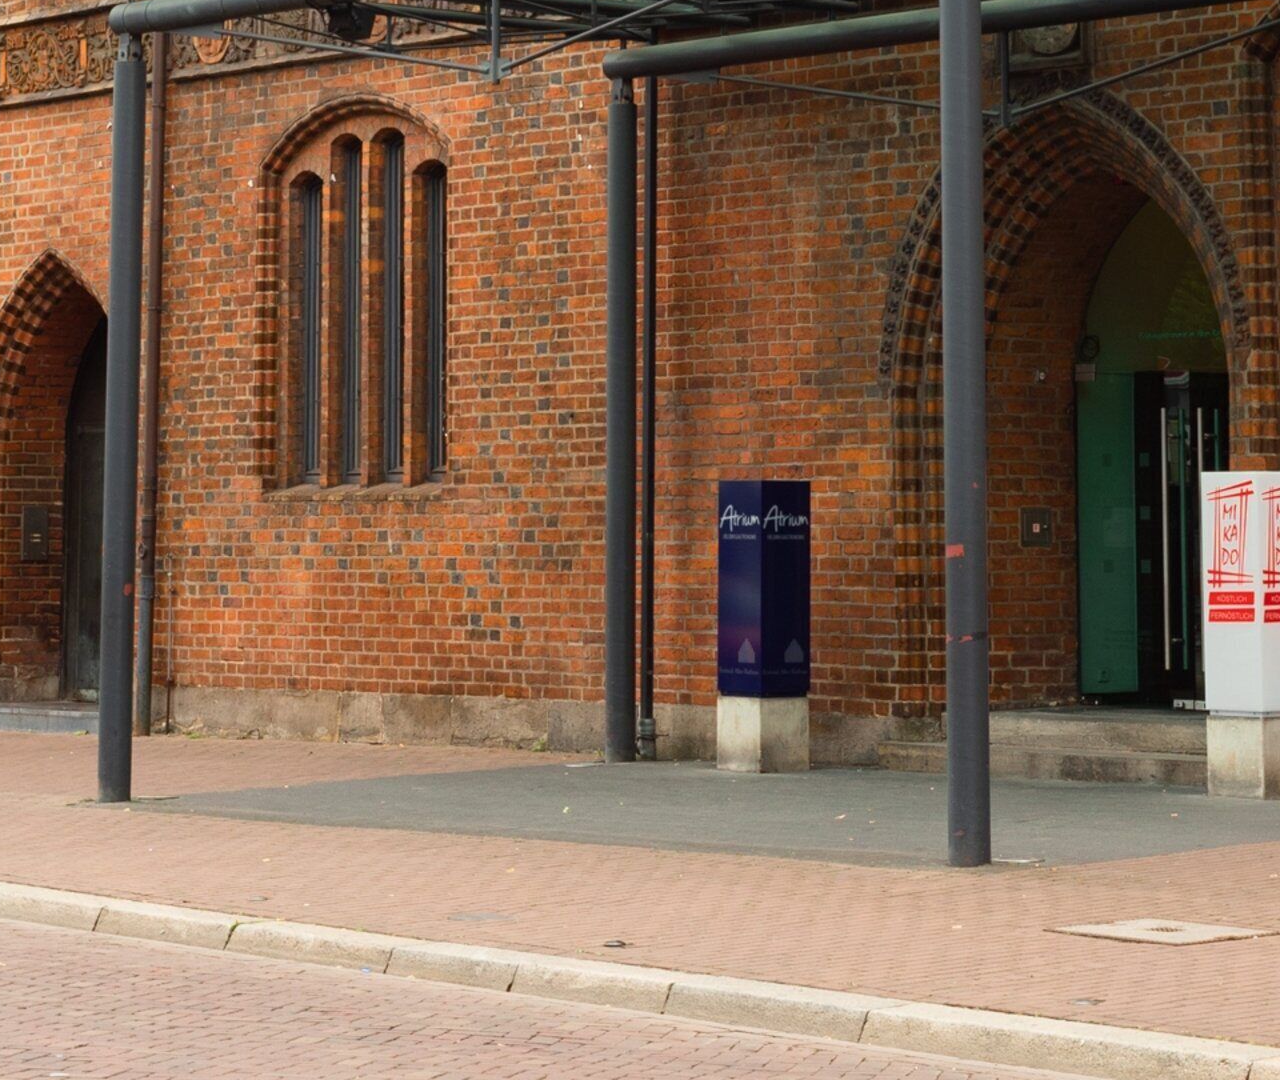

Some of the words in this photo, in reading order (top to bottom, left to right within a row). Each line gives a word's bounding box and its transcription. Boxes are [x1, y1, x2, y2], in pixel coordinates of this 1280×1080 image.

[720, 504, 760, 532] Atrium
[763, 504, 808, 532] Atrium
[1210, 610, 1253, 620] FERNÖSTLICH
